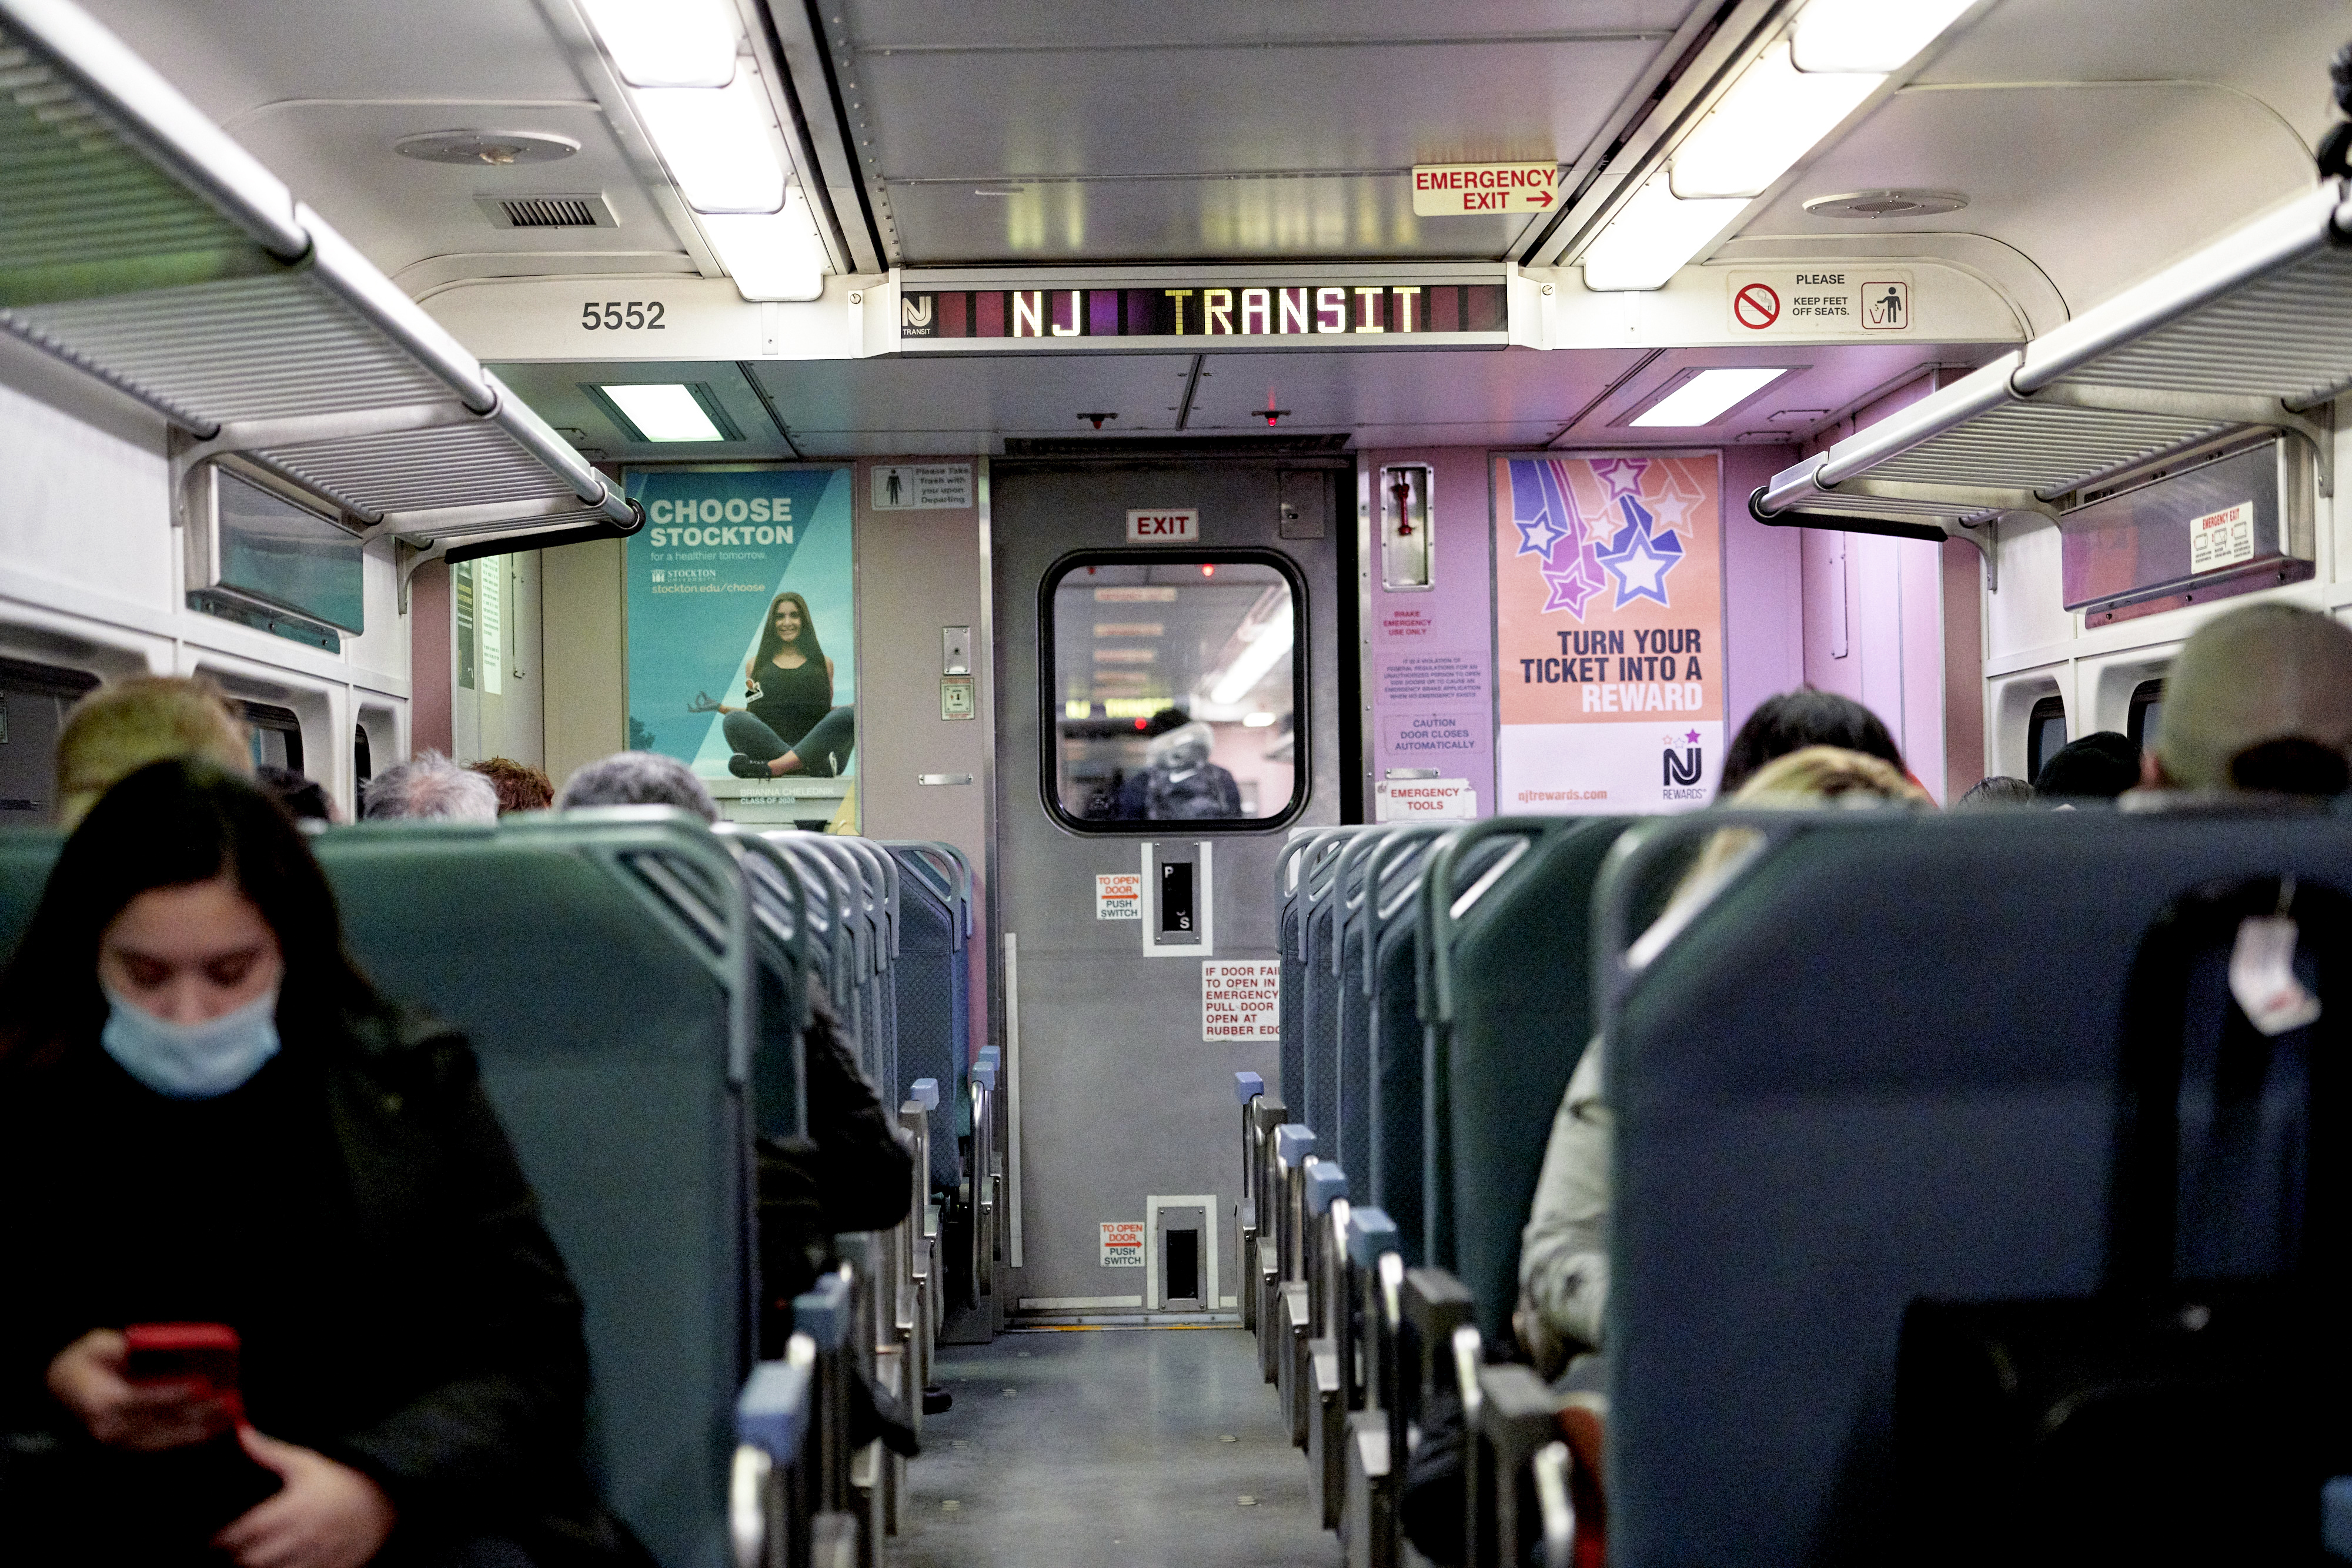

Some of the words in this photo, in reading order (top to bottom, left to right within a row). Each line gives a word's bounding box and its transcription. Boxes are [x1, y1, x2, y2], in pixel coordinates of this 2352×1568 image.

[1416, 169, 1555, 190] EMERGENCY
[1464, 192, 1510, 210] EXIT
[1796, 274, 1845, 285] PLEASE
[1794, 297, 1820, 305] KEEP
[1823, 297, 1848, 305] FEET
[582, 302, 665, 330] 5552
[901, 296, 931, 327] NJ
[1013, 290, 1080, 337] NJ
[1165, 286, 1421, 335] TRANSIT
[1793, 307, 1812, 316] OFF
[1815, 307, 1849, 316] SEATS.
[650, 498, 792, 524] CHOOSE
[2203, 511, 2229, 530] EMERGENCY
[2230, 508, 2240, 522] EXIT
[1137, 516, 1189, 534] EXIT
[650, 526, 793, 547] STOCKTON
[650, 551, 664, 561] for
[676, 551, 716, 561] healthier
[652, 583, 765, 594] stockton.edu/choose
[1557, 630, 1624, 656] TURN
[1633, 628, 1701, 654] YOUR
[1520, 657, 1609, 683] TICKET
[1619, 656, 1676, 682] INTO
[1685, 656, 1702, 681] A
[1582, 682, 1702, 713] REWARD
[1413, 719, 1456, 727] CAUTION
[1401, 731, 1428, 739] DOOR
[1395, 741, 1474, 750] AUTOMATICALLY
[1663, 748, 1702, 786] NJ
[740, 788, 780, 796] BRIANNA
[1391, 788, 1459, 797] EMERGENCY
[1518, 790, 1608, 803] njtrewards.com
[1663, 789, 1702, 800] REWARDS
[1407, 801, 1444, 810] TOOLS
[1101, 909, 1138, 917] SWITCH
[1206, 967, 1215, 976] IF
[1221, 967, 1254, 976] DOOR
[1207, 979, 1221, 988] TO
[1226, 979, 1258, 987] OPEN
[1264, 979, 1275, 987] IN
[1207, 990, 1279, 999] EMERGENCY
[1207, 1002, 1235, 1011] PULL
[1241, 1002, 1274, 1011] DOOR
[1207, 1015, 1238, 1023] OPEN
[1244, 1014, 1257, 1023] AT
[1207, 1026, 1254, 1035] RUBBER
